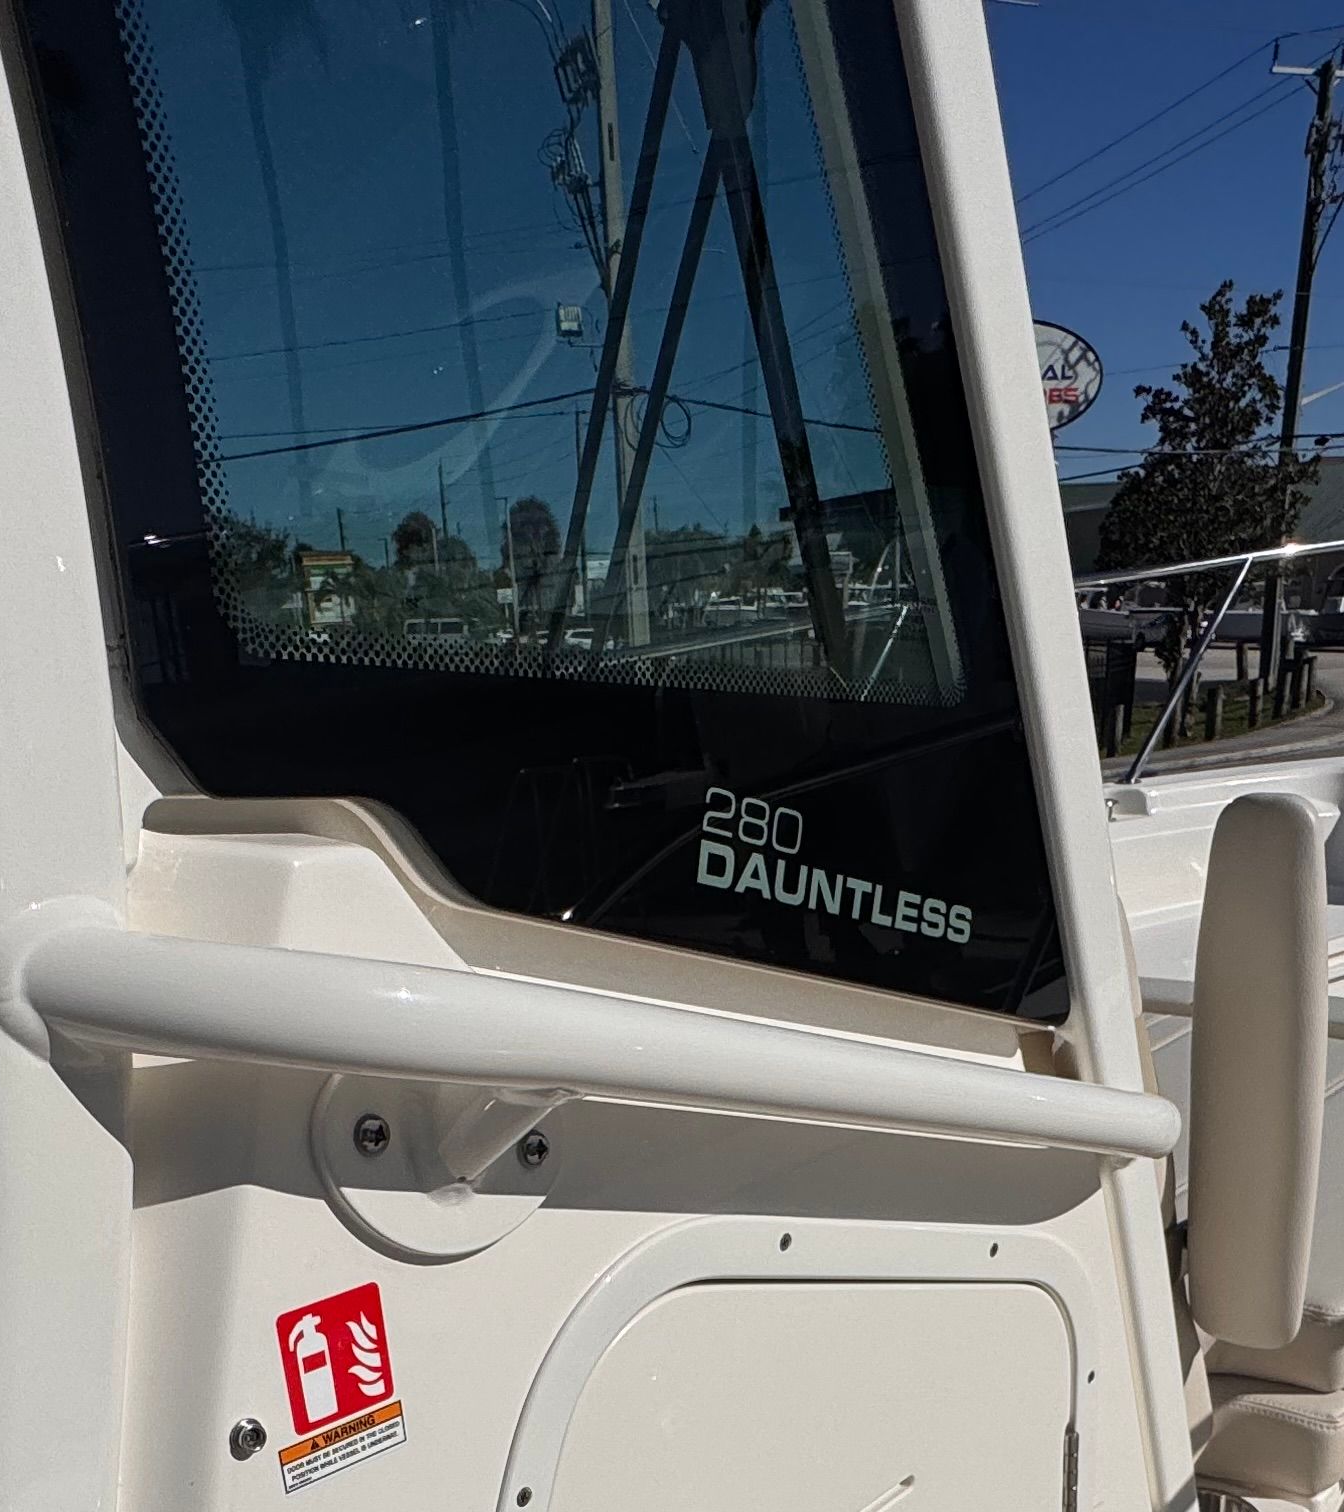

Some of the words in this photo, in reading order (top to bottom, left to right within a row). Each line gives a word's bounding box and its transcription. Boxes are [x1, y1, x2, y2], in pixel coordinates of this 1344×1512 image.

[1041, 364, 1074, 381] AL
[1043, 387, 1080, 405] BS
[701, 786, 803, 856] 280
[696, 838, 975, 945] DAUNTLESS
[322, 1414, 376, 1444] WARNING
[287, 1460, 305, 1475] DOOR
[291, 1466, 319, 1482] POSITION
